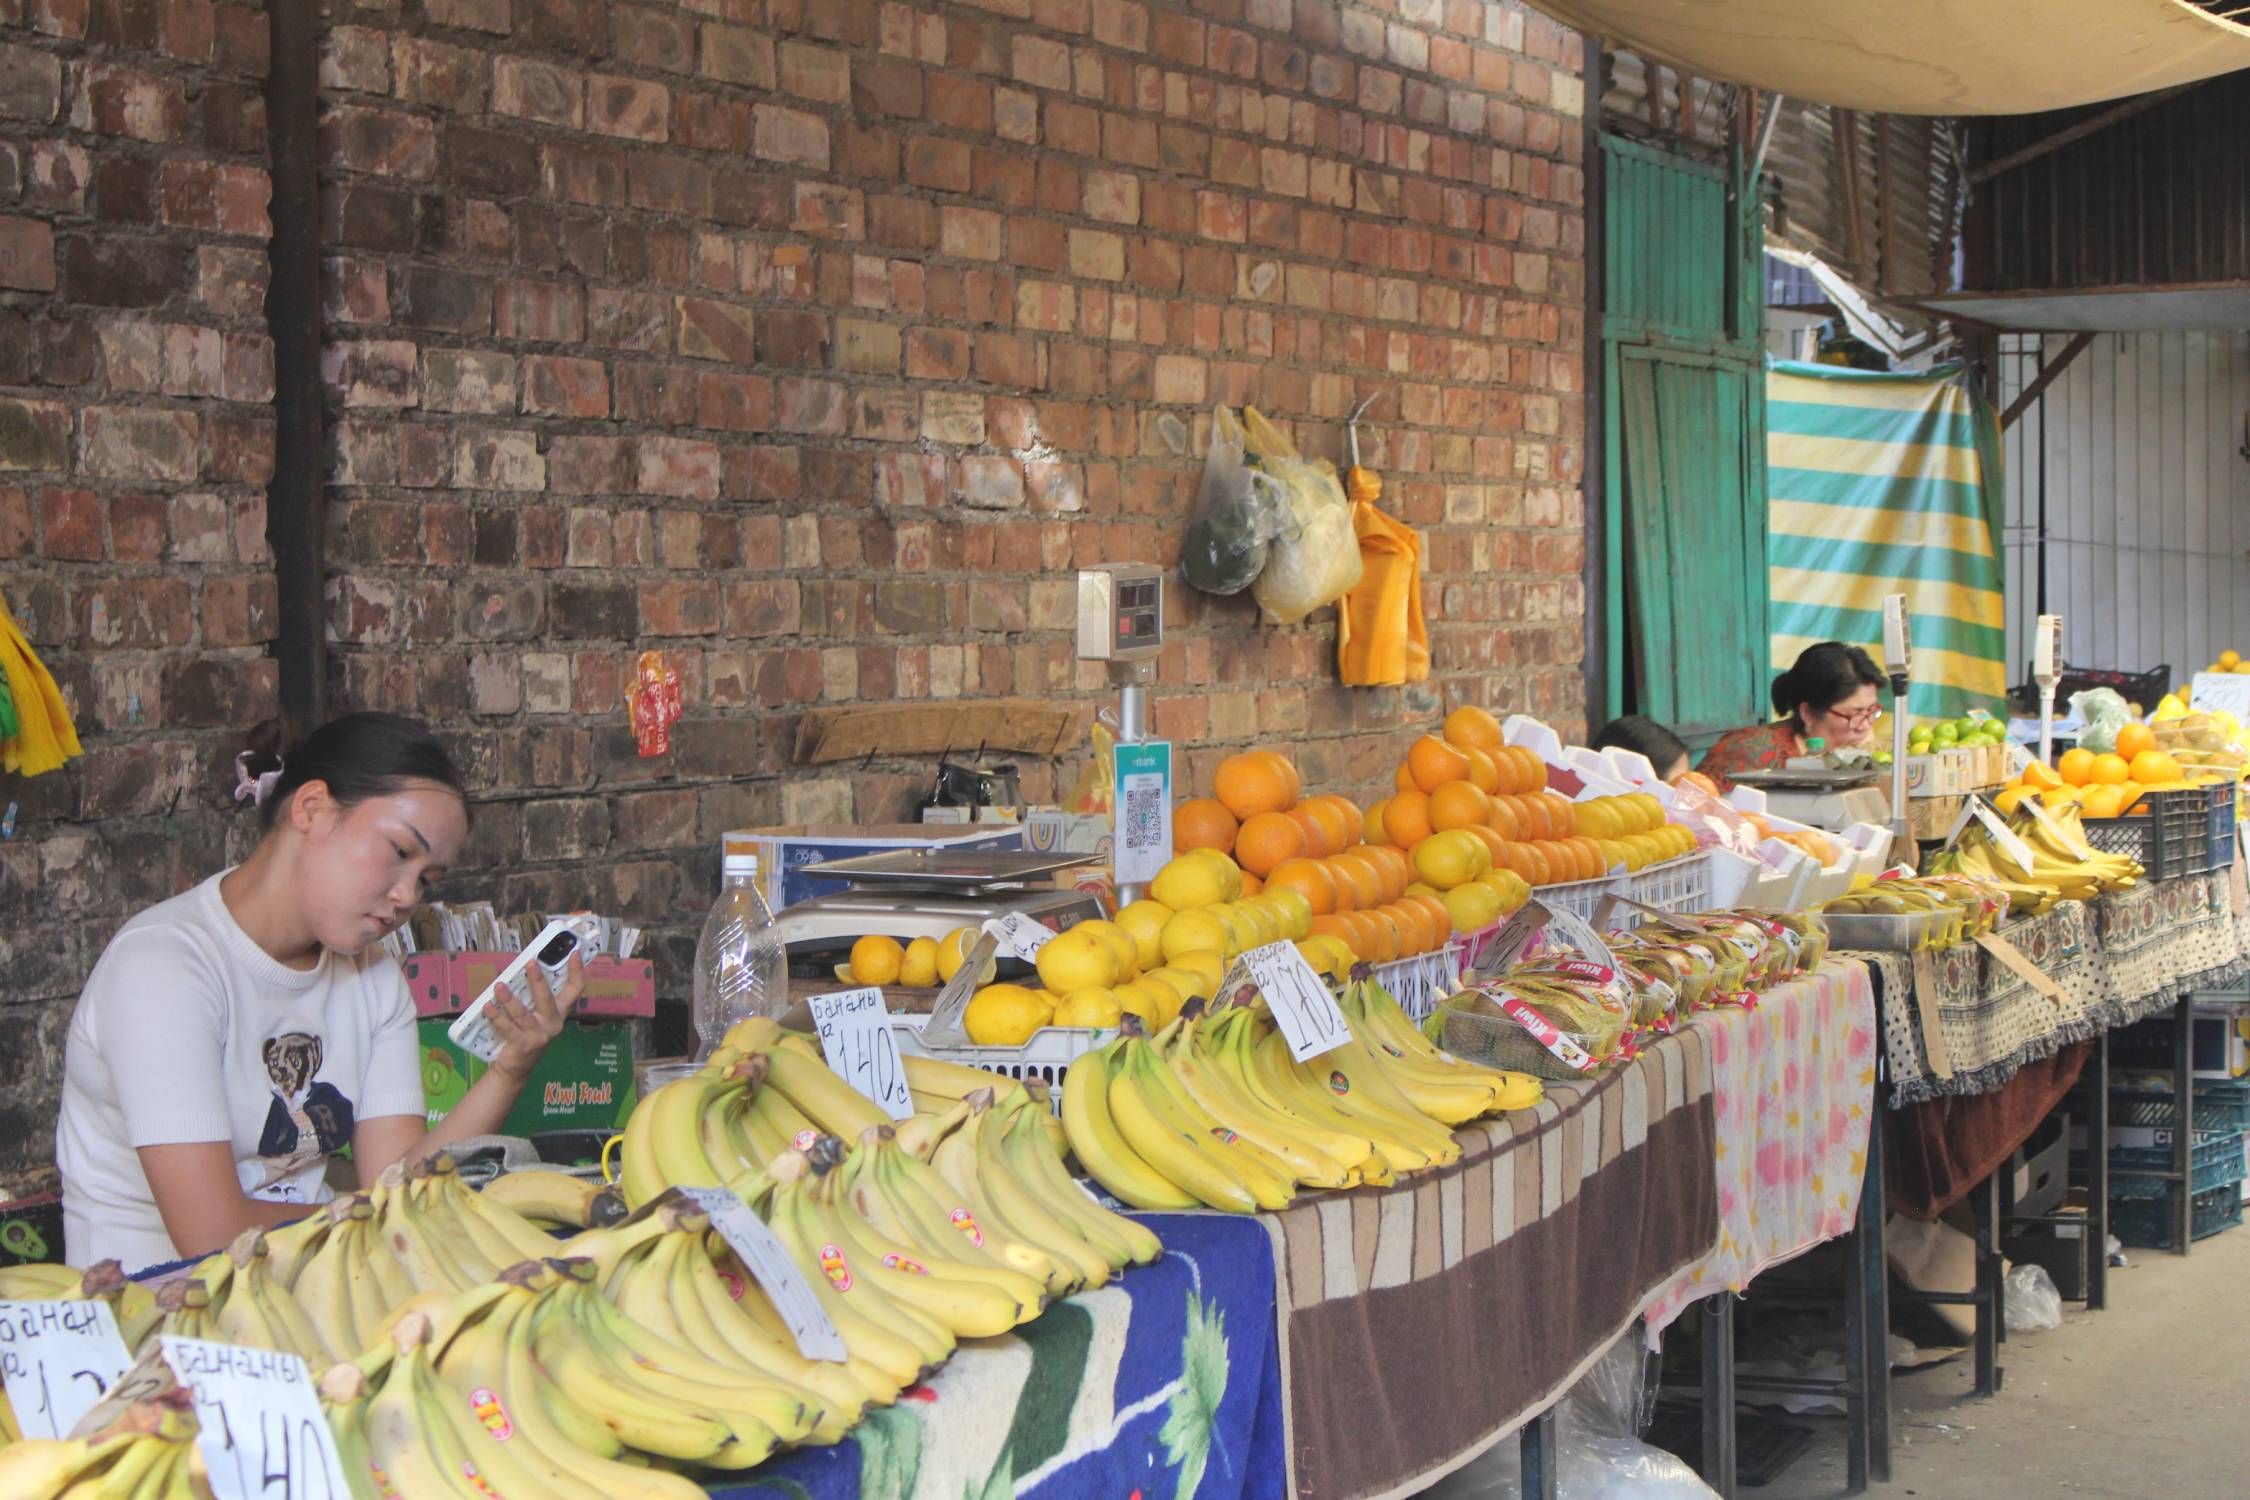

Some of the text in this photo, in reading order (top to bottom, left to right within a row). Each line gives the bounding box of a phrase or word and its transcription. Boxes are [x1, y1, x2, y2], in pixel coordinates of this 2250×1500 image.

[812, 989, 877, 1019] Бананы
[544, 1081, 612, 1105] Kiwi Fruit
[175, 1343, 304, 1385] Бананы
